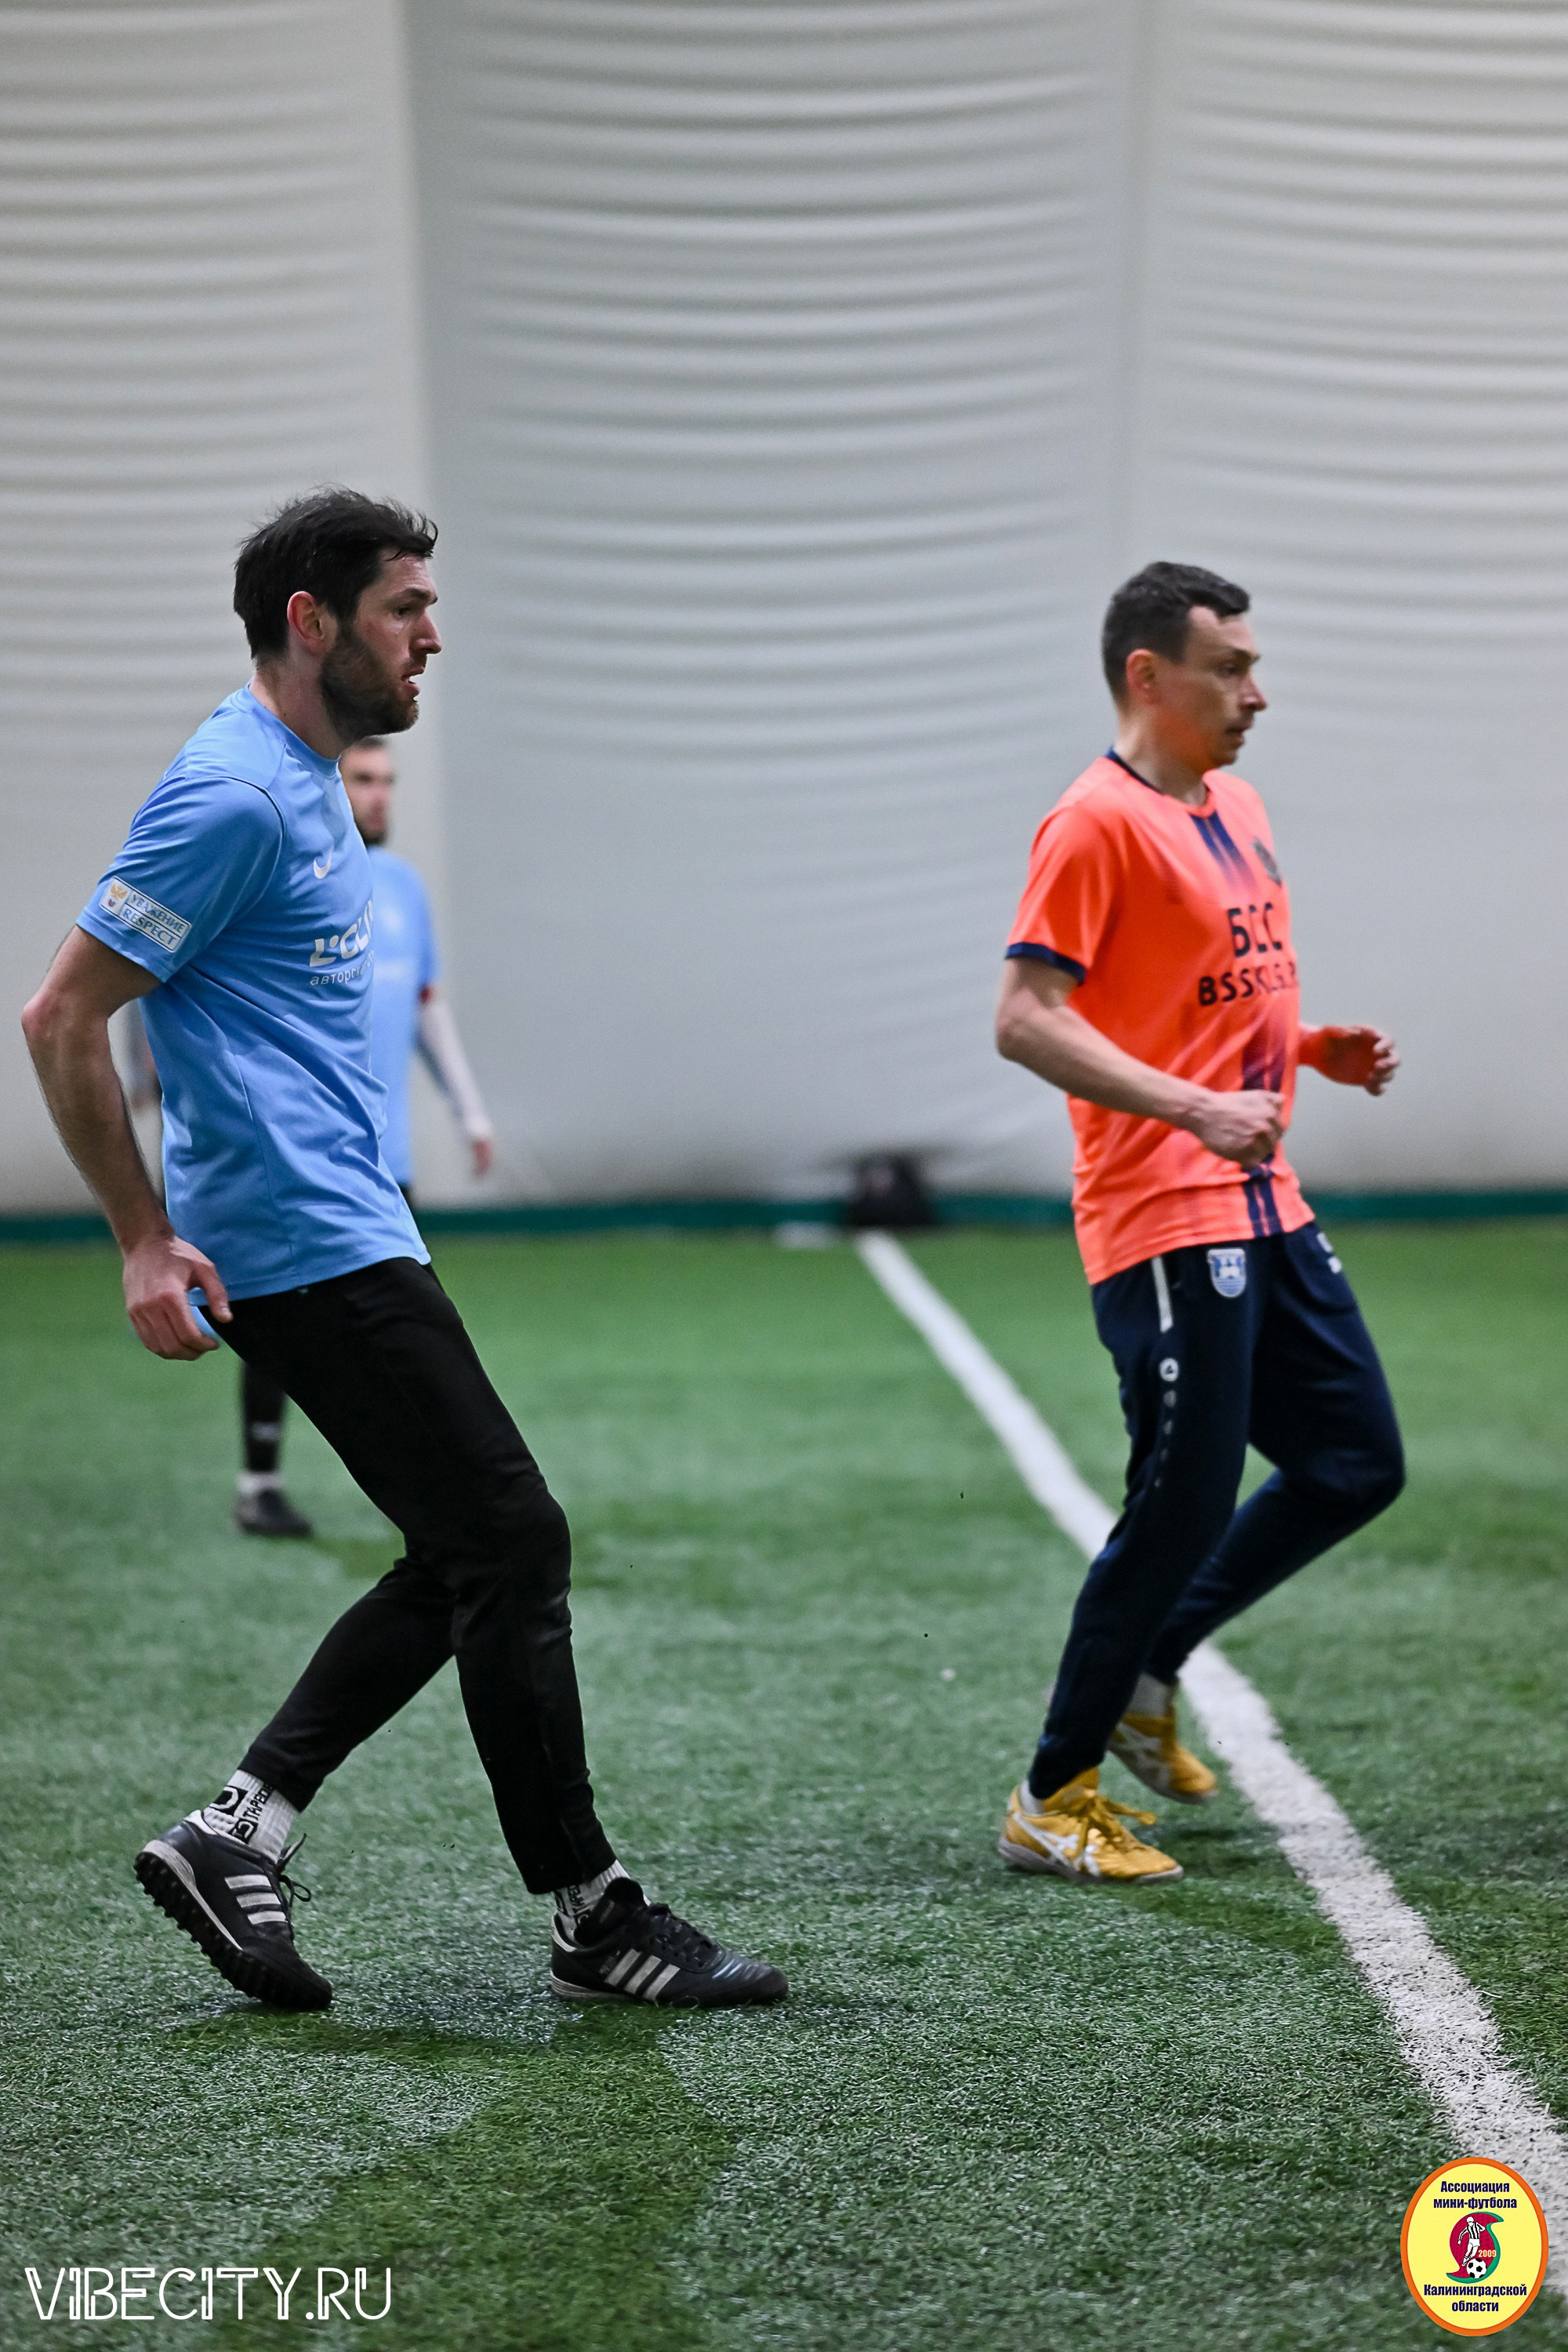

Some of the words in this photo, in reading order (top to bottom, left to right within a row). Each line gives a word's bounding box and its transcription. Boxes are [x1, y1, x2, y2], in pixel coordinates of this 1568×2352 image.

[123, 908, 177, 946] RESPECT
[131, 894, 186, 934] УВАЖЕНИЕ
[1227, 902, 1283, 958] БСС
